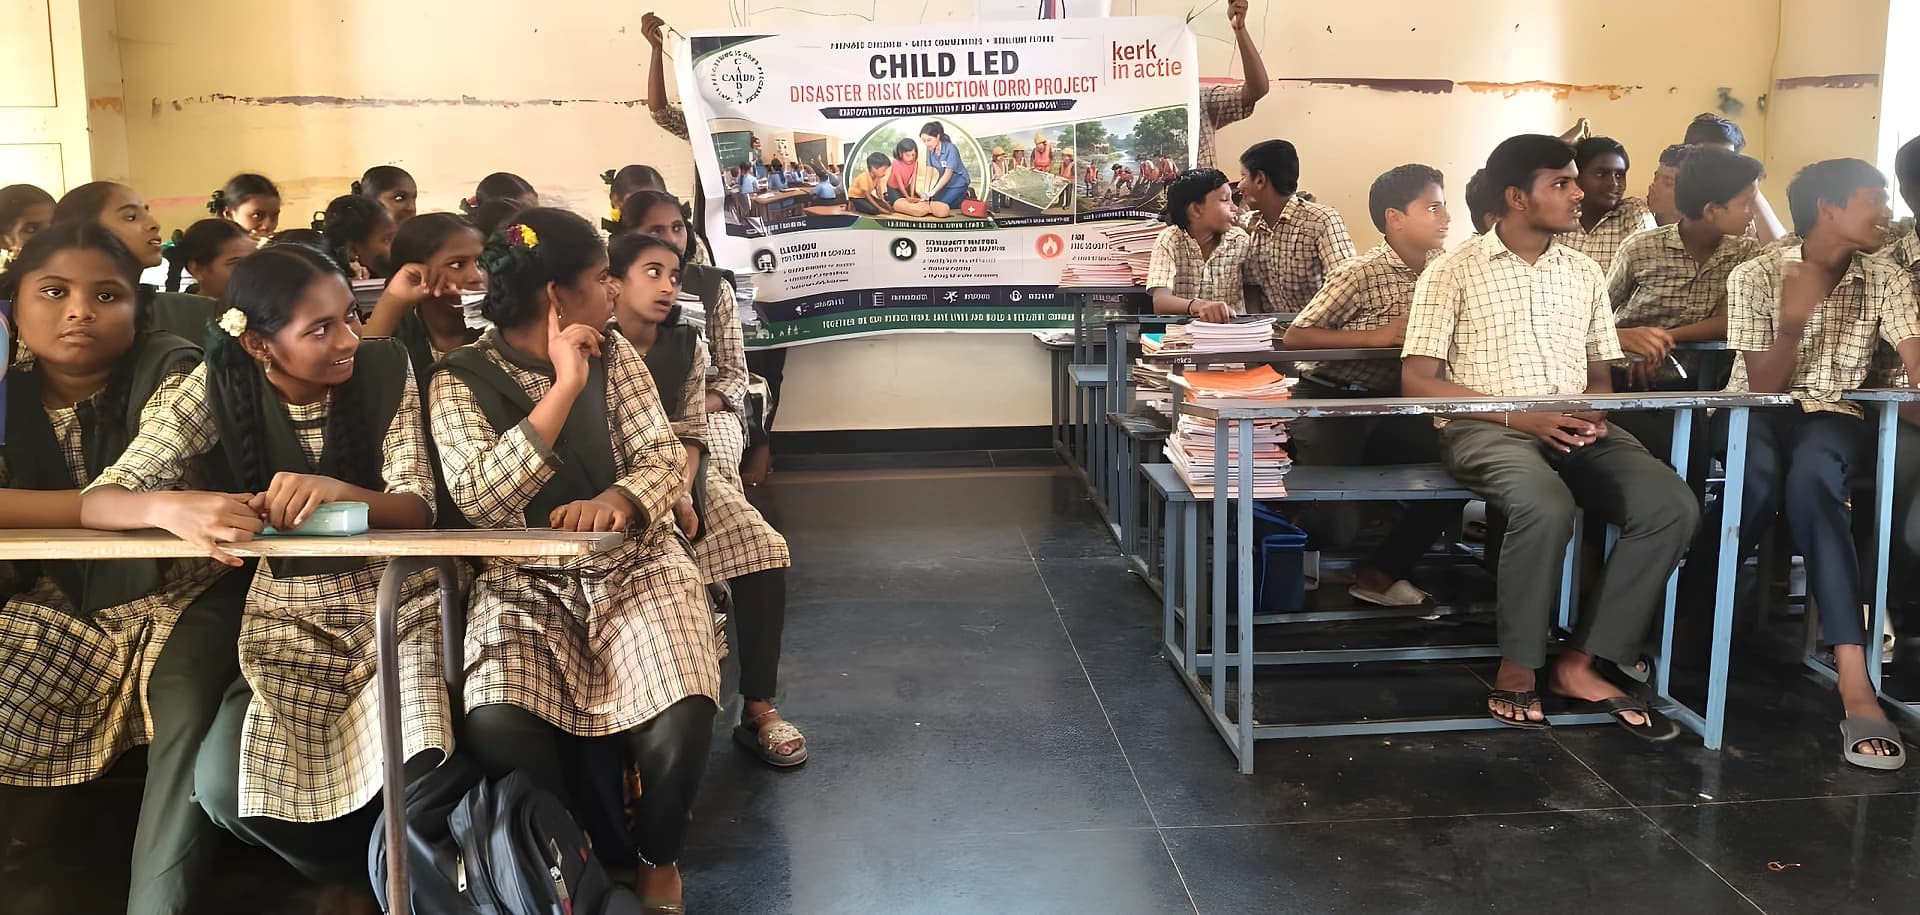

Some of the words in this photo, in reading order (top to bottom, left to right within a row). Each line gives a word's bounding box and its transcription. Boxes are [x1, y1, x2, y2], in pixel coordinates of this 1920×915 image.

[1113, 39, 1157, 60] kerk
[869, 52, 956, 79] CHILD
[967, 50, 1019, 76] LED
[1112, 61, 1129, 79] in
[1134, 58, 1182, 78] actie
[790, 84, 862, 103] DISASTER
[867, 83, 902, 100] RISK
[907, 79, 989, 100] REDUCTION
[993, 78, 1031, 97] (DRR)
[1035, 76, 1098, 95] PROJECT
